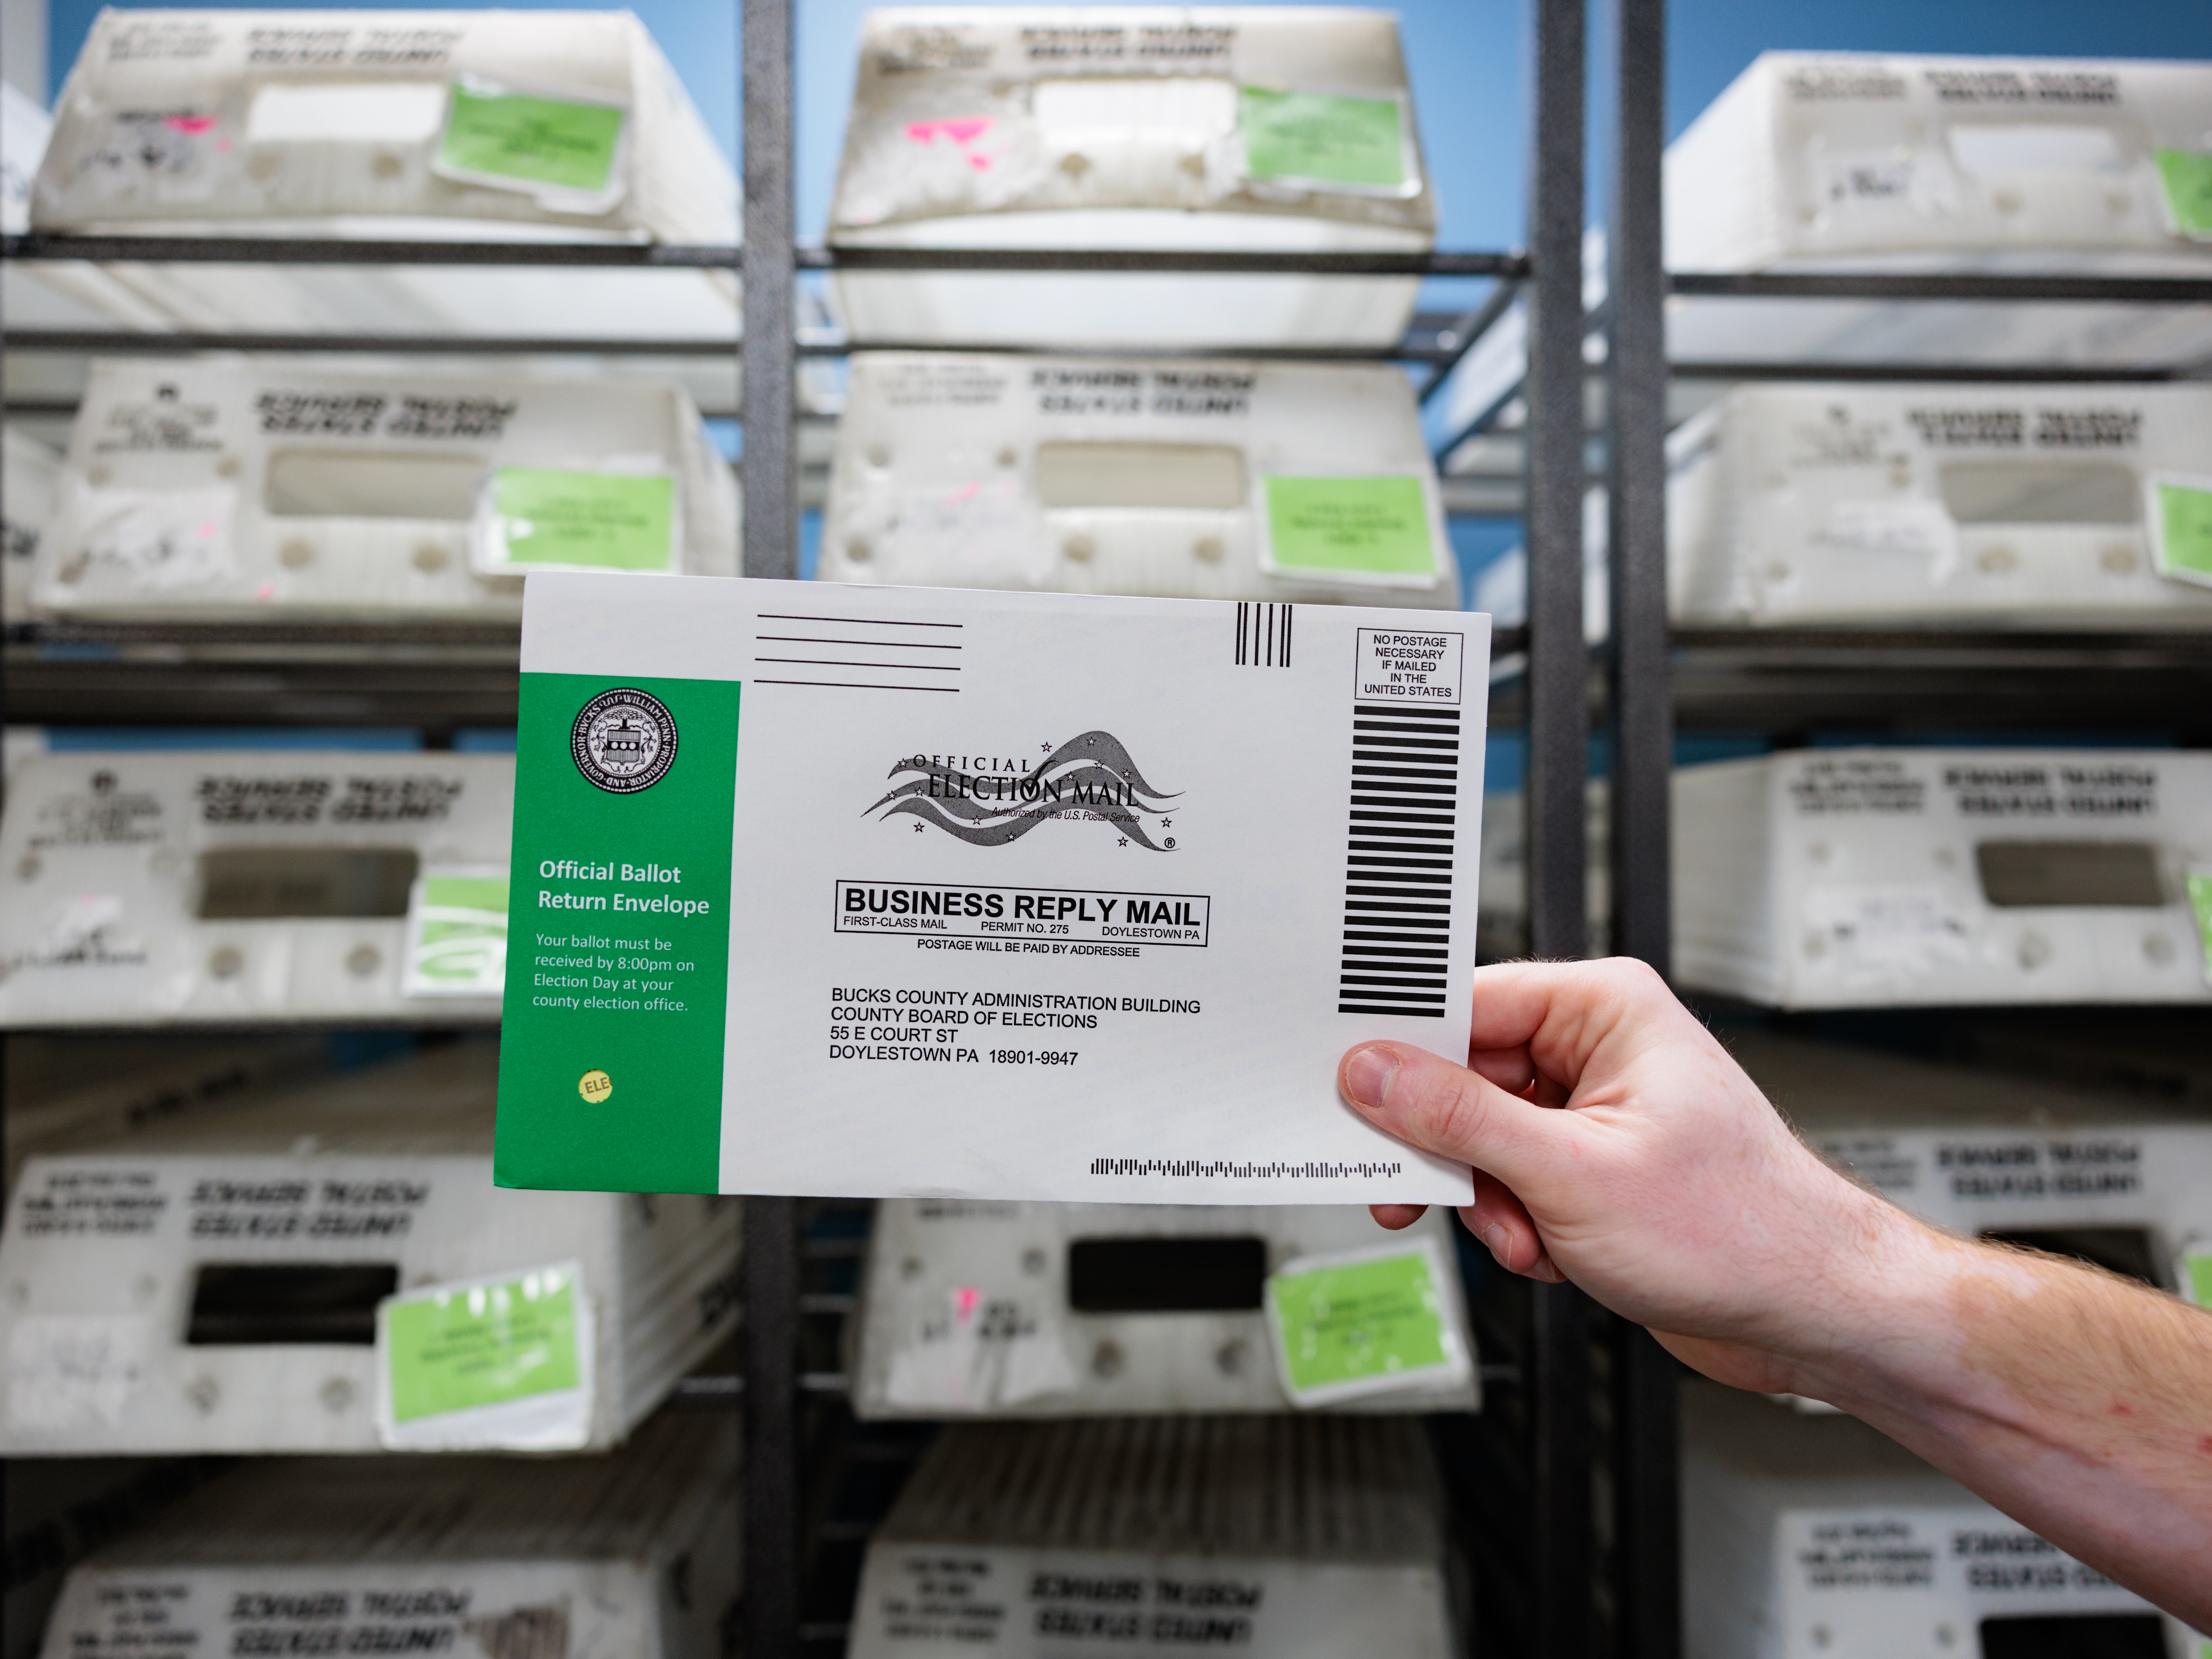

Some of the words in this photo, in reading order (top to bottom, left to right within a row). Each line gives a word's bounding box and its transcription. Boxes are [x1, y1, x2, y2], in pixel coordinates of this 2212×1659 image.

[1374, 635, 1390, 644] NO
[1394, 636, 1446, 647] POSTAGE
[1376, 647, 1444, 659] NECESSARY
[1382, 660, 1392, 669] IF
[1395, 661, 1436, 671] MAILED
[1391, 673, 1401, 682] IN
[1404, 674, 1426, 683] THE
[1365, 684, 1405, 694] UNITED
[1409, 686, 1451, 697] STATES
[623, 694, 662, 722] WILLIAM
[661, 717, 672, 742] PENN
[913, 754, 1030, 772] OFFICIAL
[928, 773, 1064, 803] ELECTION
[1072, 780, 1139, 807] MAIL
[991, 806, 1035, 818] Authorized
[1037, 809, 1048, 821] by
[1049, 810, 1062, 820] the
[1064, 811, 1081, 820] U.S.
[1083, 811, 1109, 822] Postal
[1110, 813, 1141, 823] Service
[540, 860, 613, 880] Official
[621, 864, 681, 883] Ballot
[539, 891, 606, 910] Return
[613, 894, 709, 917] Envelope
[846, 888, 1003, 917] BUSINESS
[1015, 895, 1117, 922] REPLY
[1127, 900, 1200, 926] MAIL
[844, 916, 917, 927] FIRST-CLASS
[921, 919, 947, 929] MAIL
[981, 922, 1024, 932] PERMIT
[1027, 924, 1046, 933] NO.
[1050, 924, 1068, 934] 275
[1102, 927, 1181, 938] DOYLESTOWN
[1185, 930, 1199, 939] PA
[536, 934, 567, 946] Your
[572, 935, 610, 948] ballot
[615, 939, 650, 950] must
[655, 938, 672, 950] be
[918, 939, 972, 950] POSTAGE
[976, 941, 1002, 951] WILL
[1005, 943, 1020, 952] BE
[1024, 944, 1049, 953] PAID
[1053, 944, 1068, 954] BY
[1070, 945, 1139, 956] ADDRESSEE
[535, 955, 592, 967] received
[598, 956, 614, 971] by
[618, 957, 671, 973] 8:00pm
[676, 962, 694, 971] on
[535, 973, 588, 987] Election
[593, 976, 619, 991] Day
[623, 979, 637, 989] at
[642, 981, 674, 992] your
[533, 996, 579, 1010] county
[584, 996, 639, 1009] election
[645, 998, 687, 1011] office.
[832, 988, 890, 1002] BUCKS
[896, 990, 968, 1005] COUNTY
[972, 993, 1116, 1010] ADMINISTRATION
[1122, 998, 1200, 1013] BUILDING
[832, 1007, 904, 1022] COUNTY
[909, 1009, 969, 1024] BOARD
[974, 1012, 997, 1024] OF
[1003, 1012, 1097, 1028] ELECTIONS
[831, 1026, 849, 1039] 55
[855, 1027, 865, 1040] E
[871, 1027, 932, 1041] COURT
[937, 1029, 958, 1042] ST
[830, 1045, 950, 1061] DOYLESTOWN
[957, 1049, 979, 1062] PA
[990, 1050, 1078, 1065] 18901-9947
